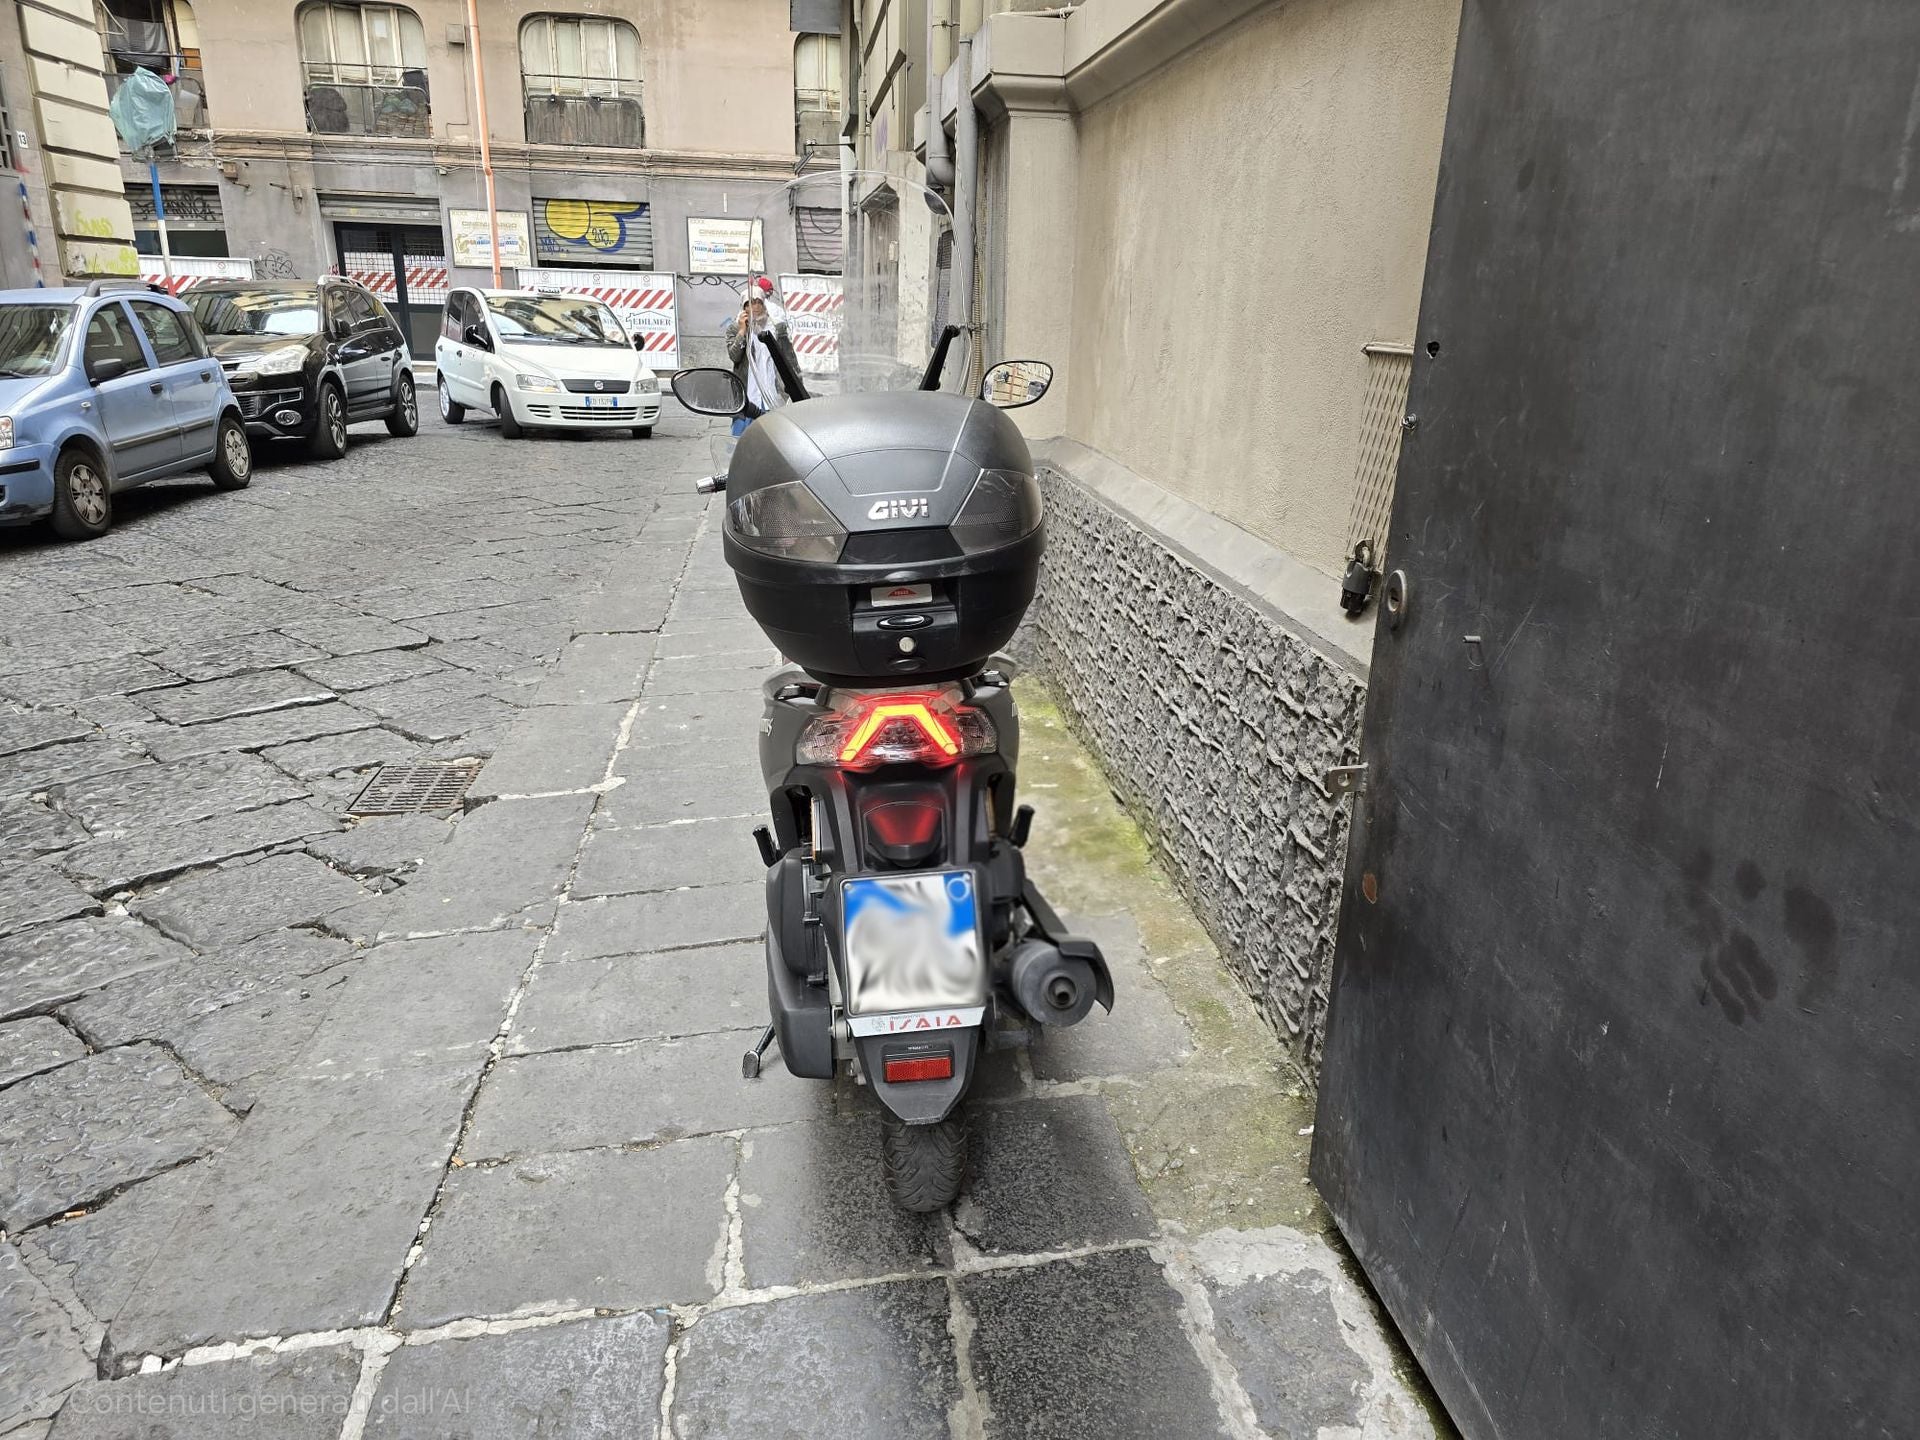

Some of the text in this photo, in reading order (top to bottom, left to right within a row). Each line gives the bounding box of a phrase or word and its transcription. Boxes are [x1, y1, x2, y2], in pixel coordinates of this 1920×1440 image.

[18, 134, 27, 146] 13
[633, 317, 671, 326] EDILMER
[868, 498, 929, 520] GIVI
[889, 1015, 962, 1031] ISAIA
